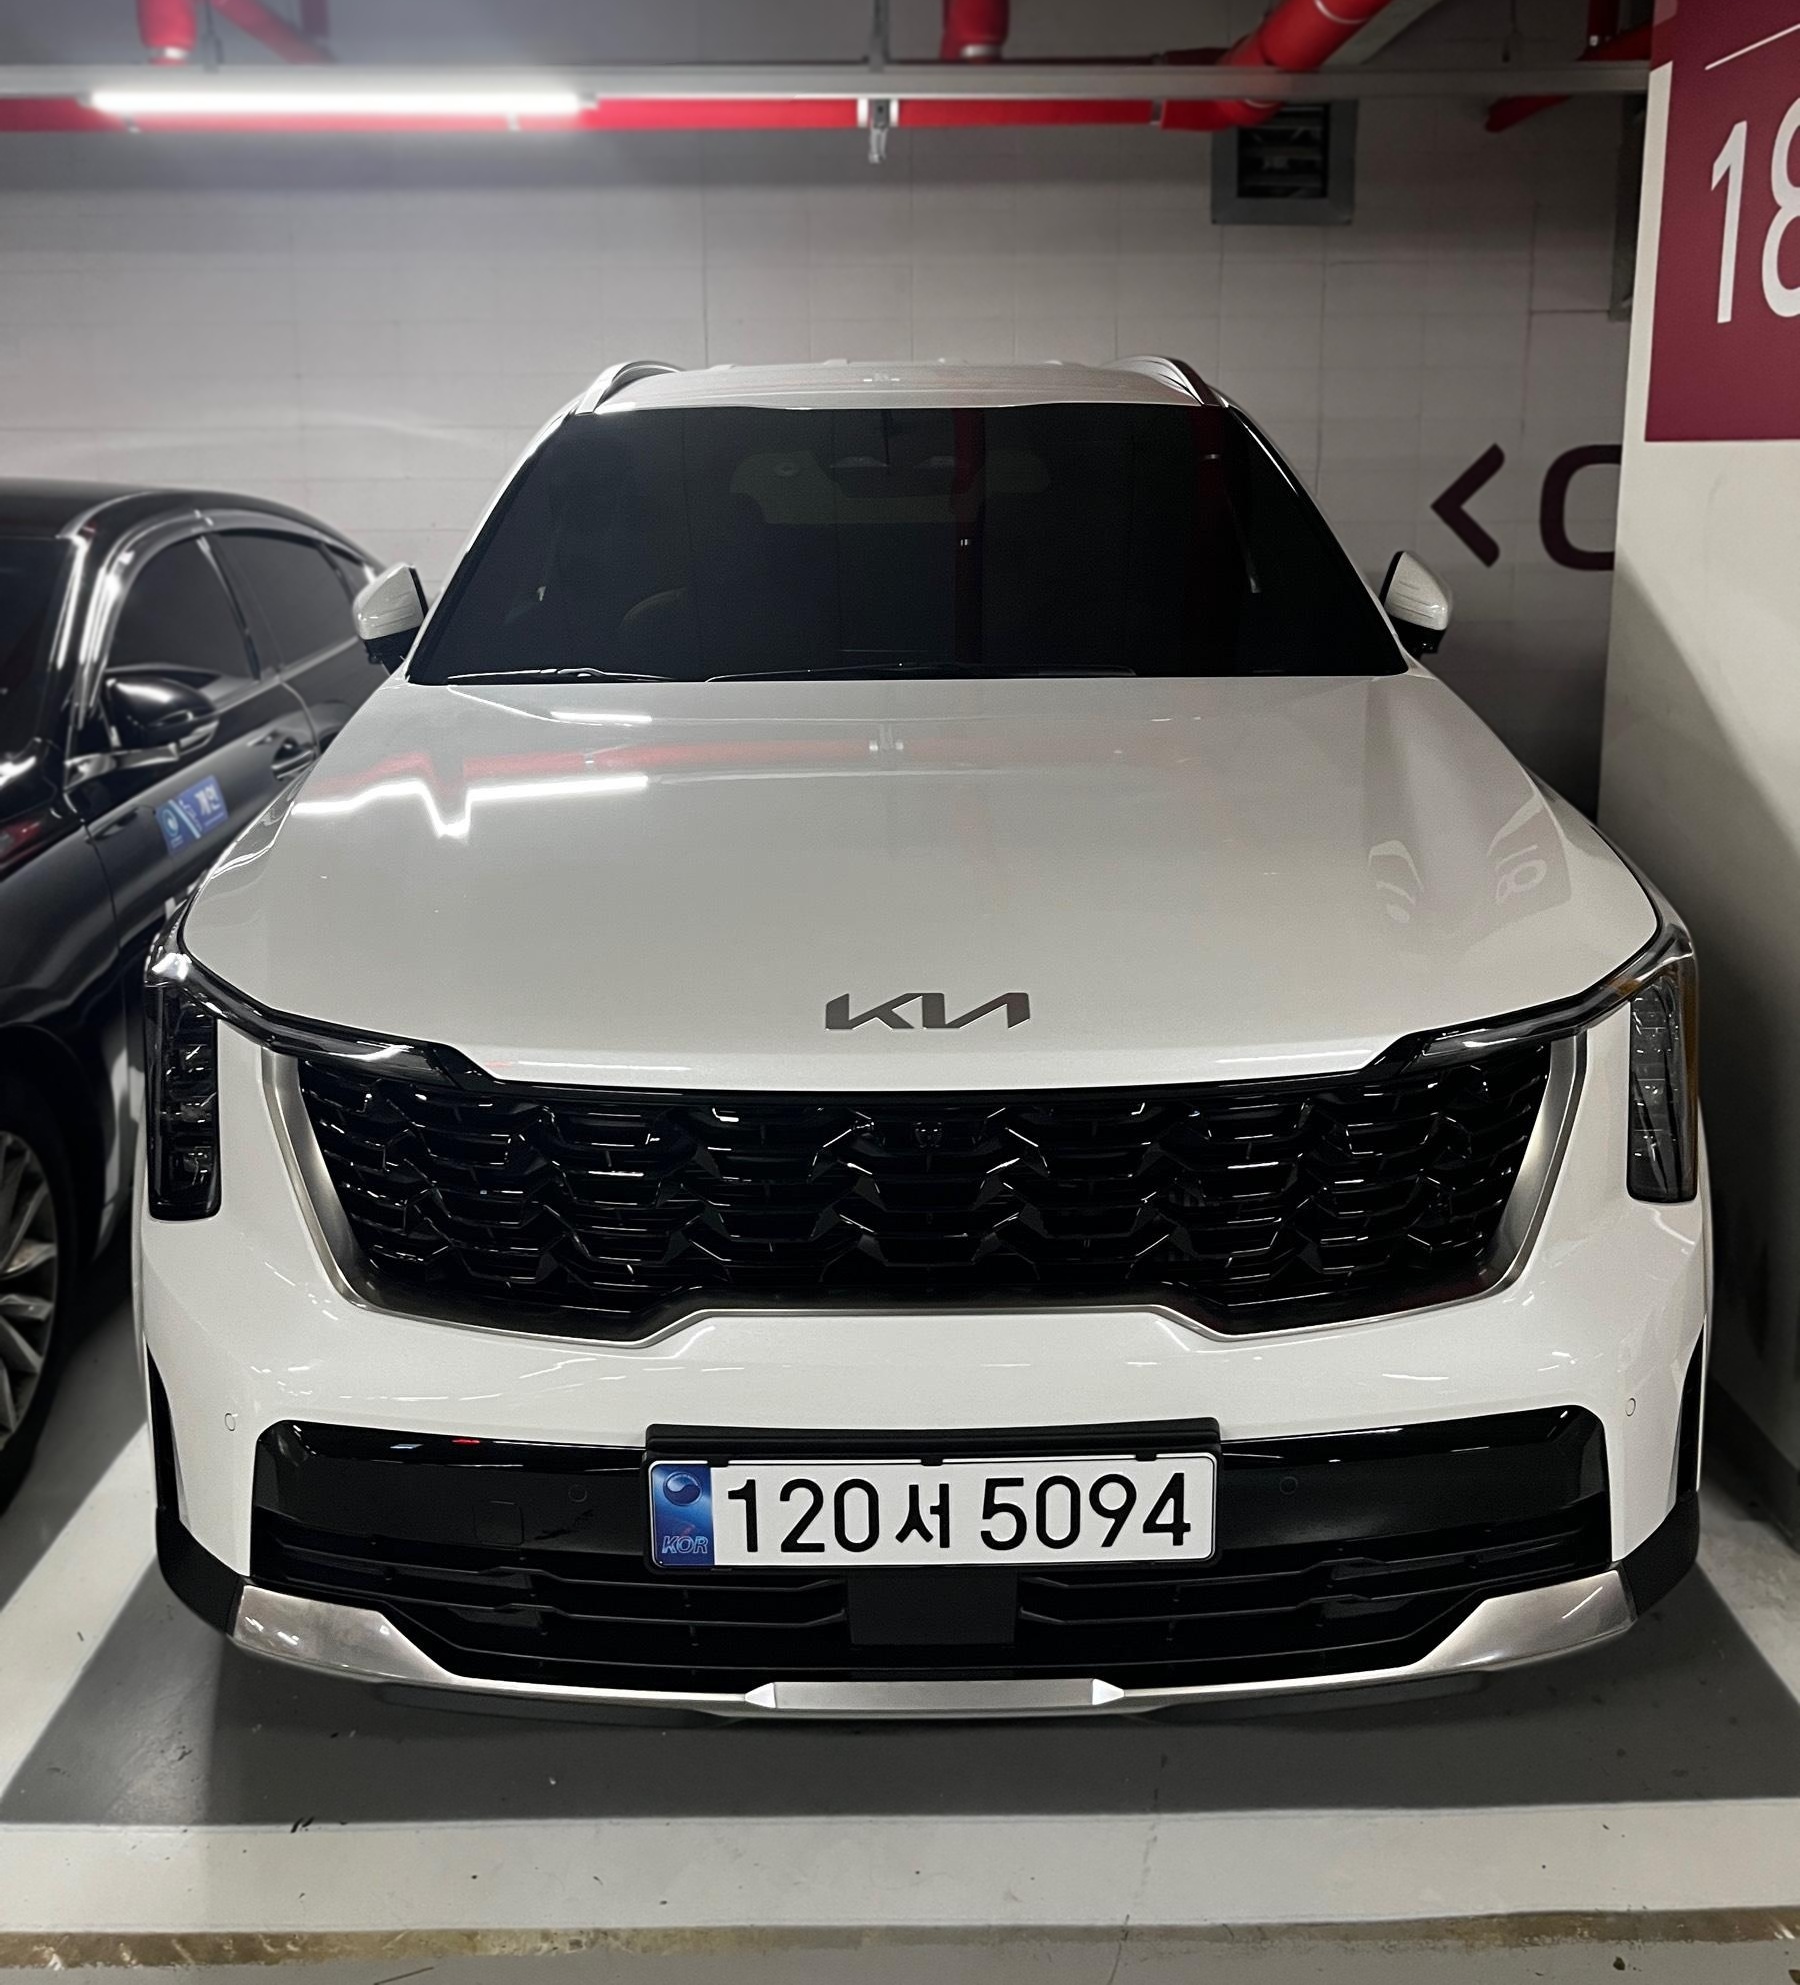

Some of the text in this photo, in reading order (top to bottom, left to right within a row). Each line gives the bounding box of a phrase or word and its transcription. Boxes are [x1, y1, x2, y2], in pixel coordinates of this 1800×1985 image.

[826, 992, 1030, 1029] KIA
[727, 1473, 1191, 1552] 120서 5094
[661, 1535, 708, 1554] KOR
